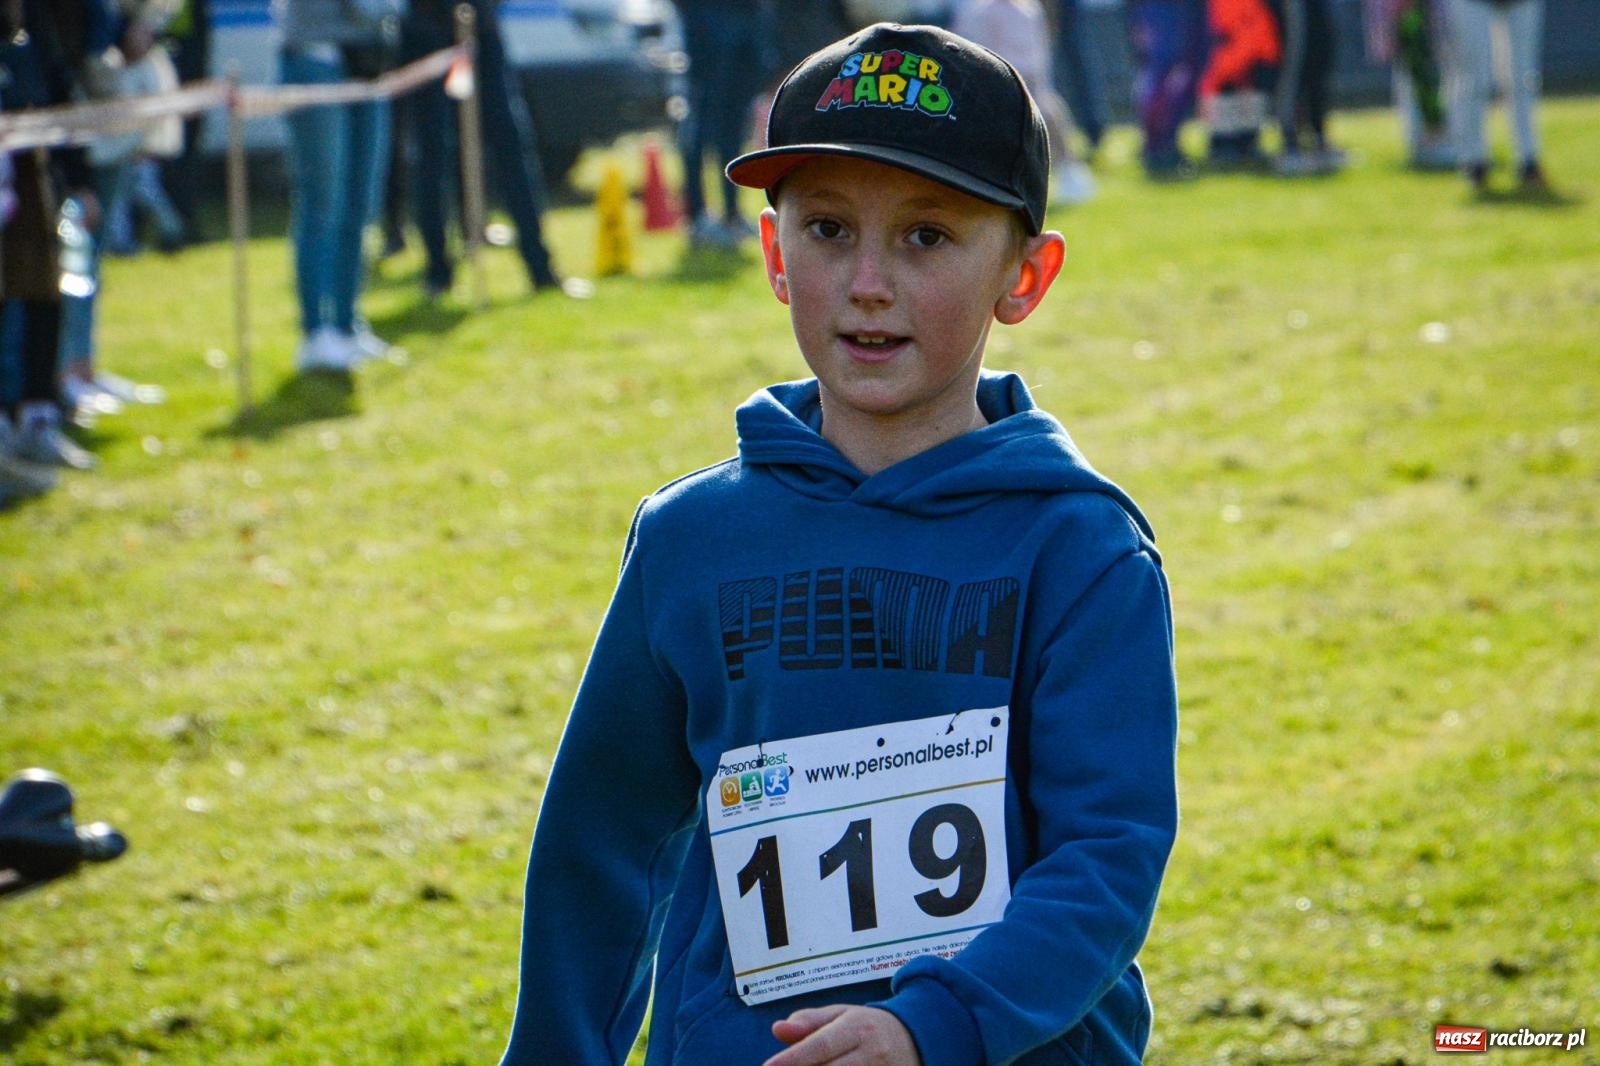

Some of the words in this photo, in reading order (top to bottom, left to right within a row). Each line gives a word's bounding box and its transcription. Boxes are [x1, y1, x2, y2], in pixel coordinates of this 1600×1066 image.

[840, 50, 942, 82] SUPER
[816, 74, 953, 115] MARIO
[805, 735, 994, 783] www.personalbest.pl
[737, 803, 987, 950] 119
